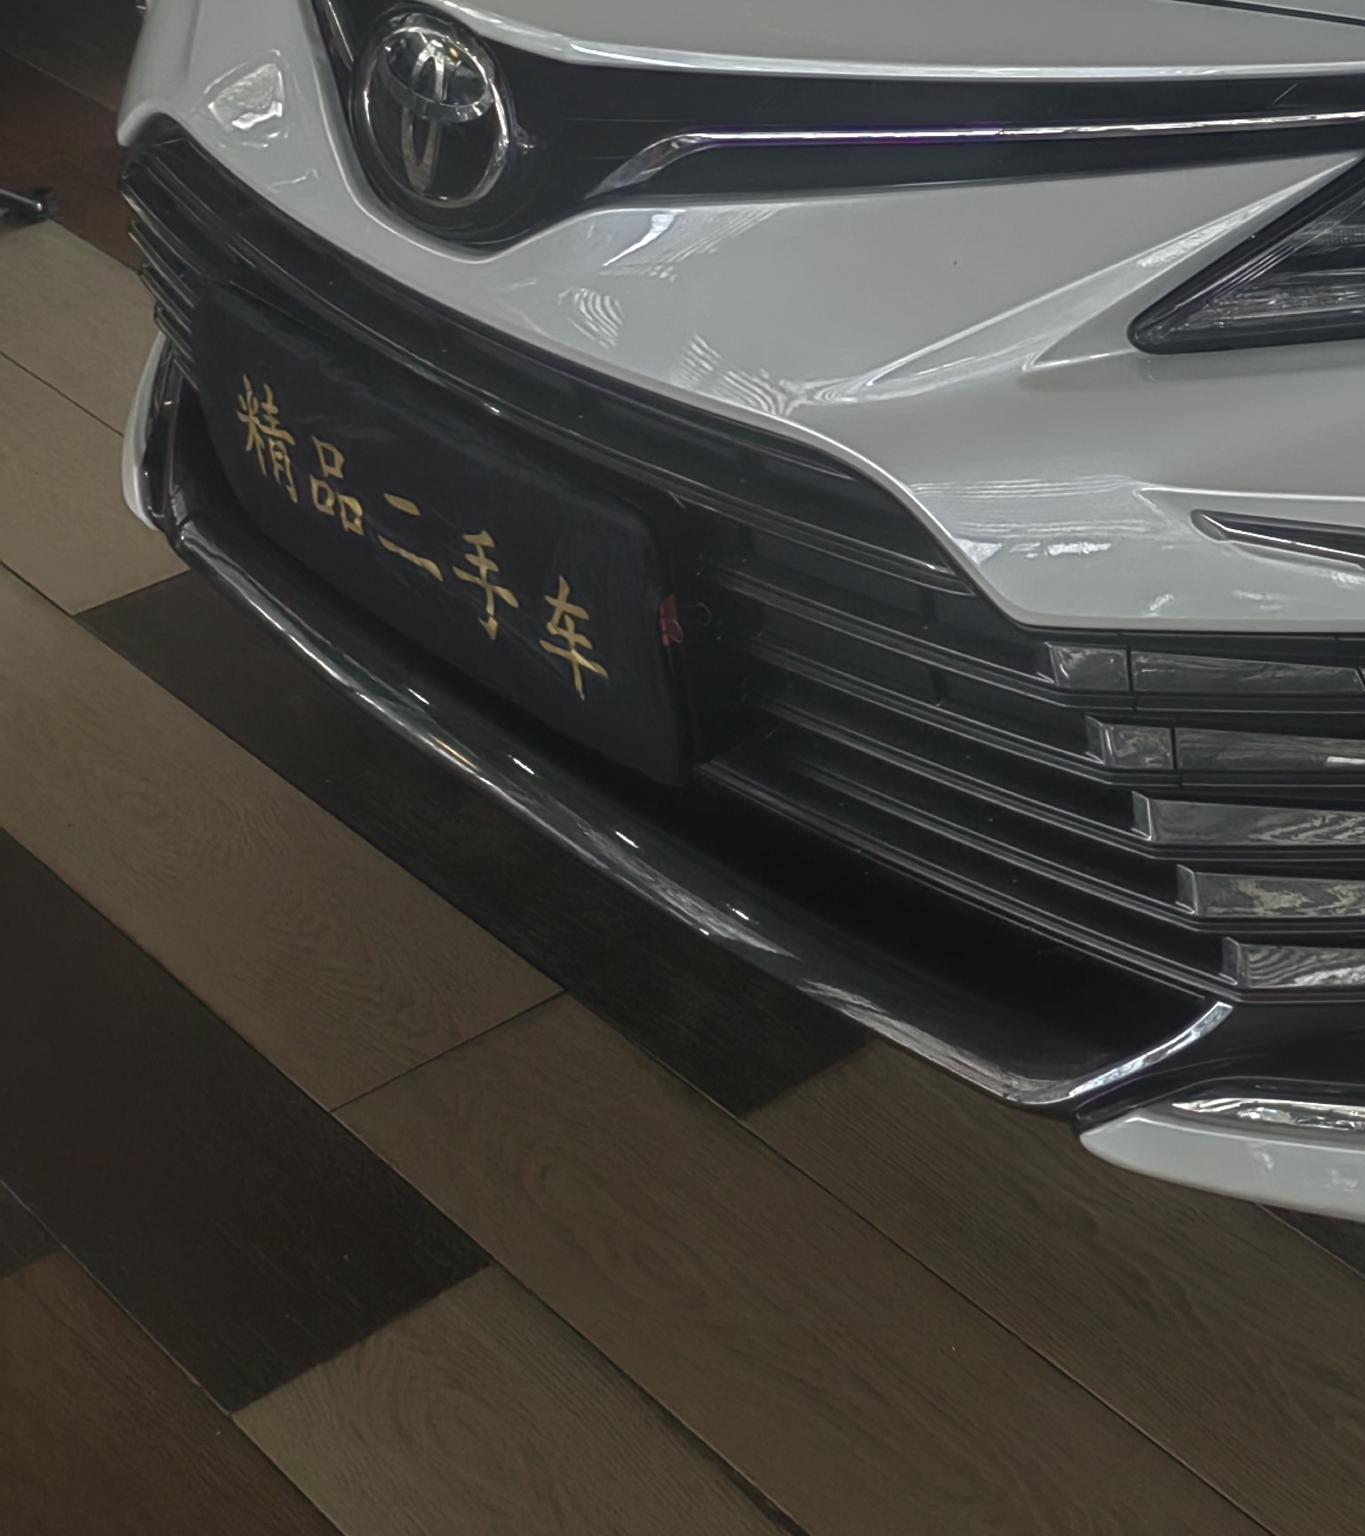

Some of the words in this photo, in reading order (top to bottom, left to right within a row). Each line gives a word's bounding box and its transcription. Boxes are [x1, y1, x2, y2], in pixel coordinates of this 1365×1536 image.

[236, 373, 608, 701] 精品二手车
